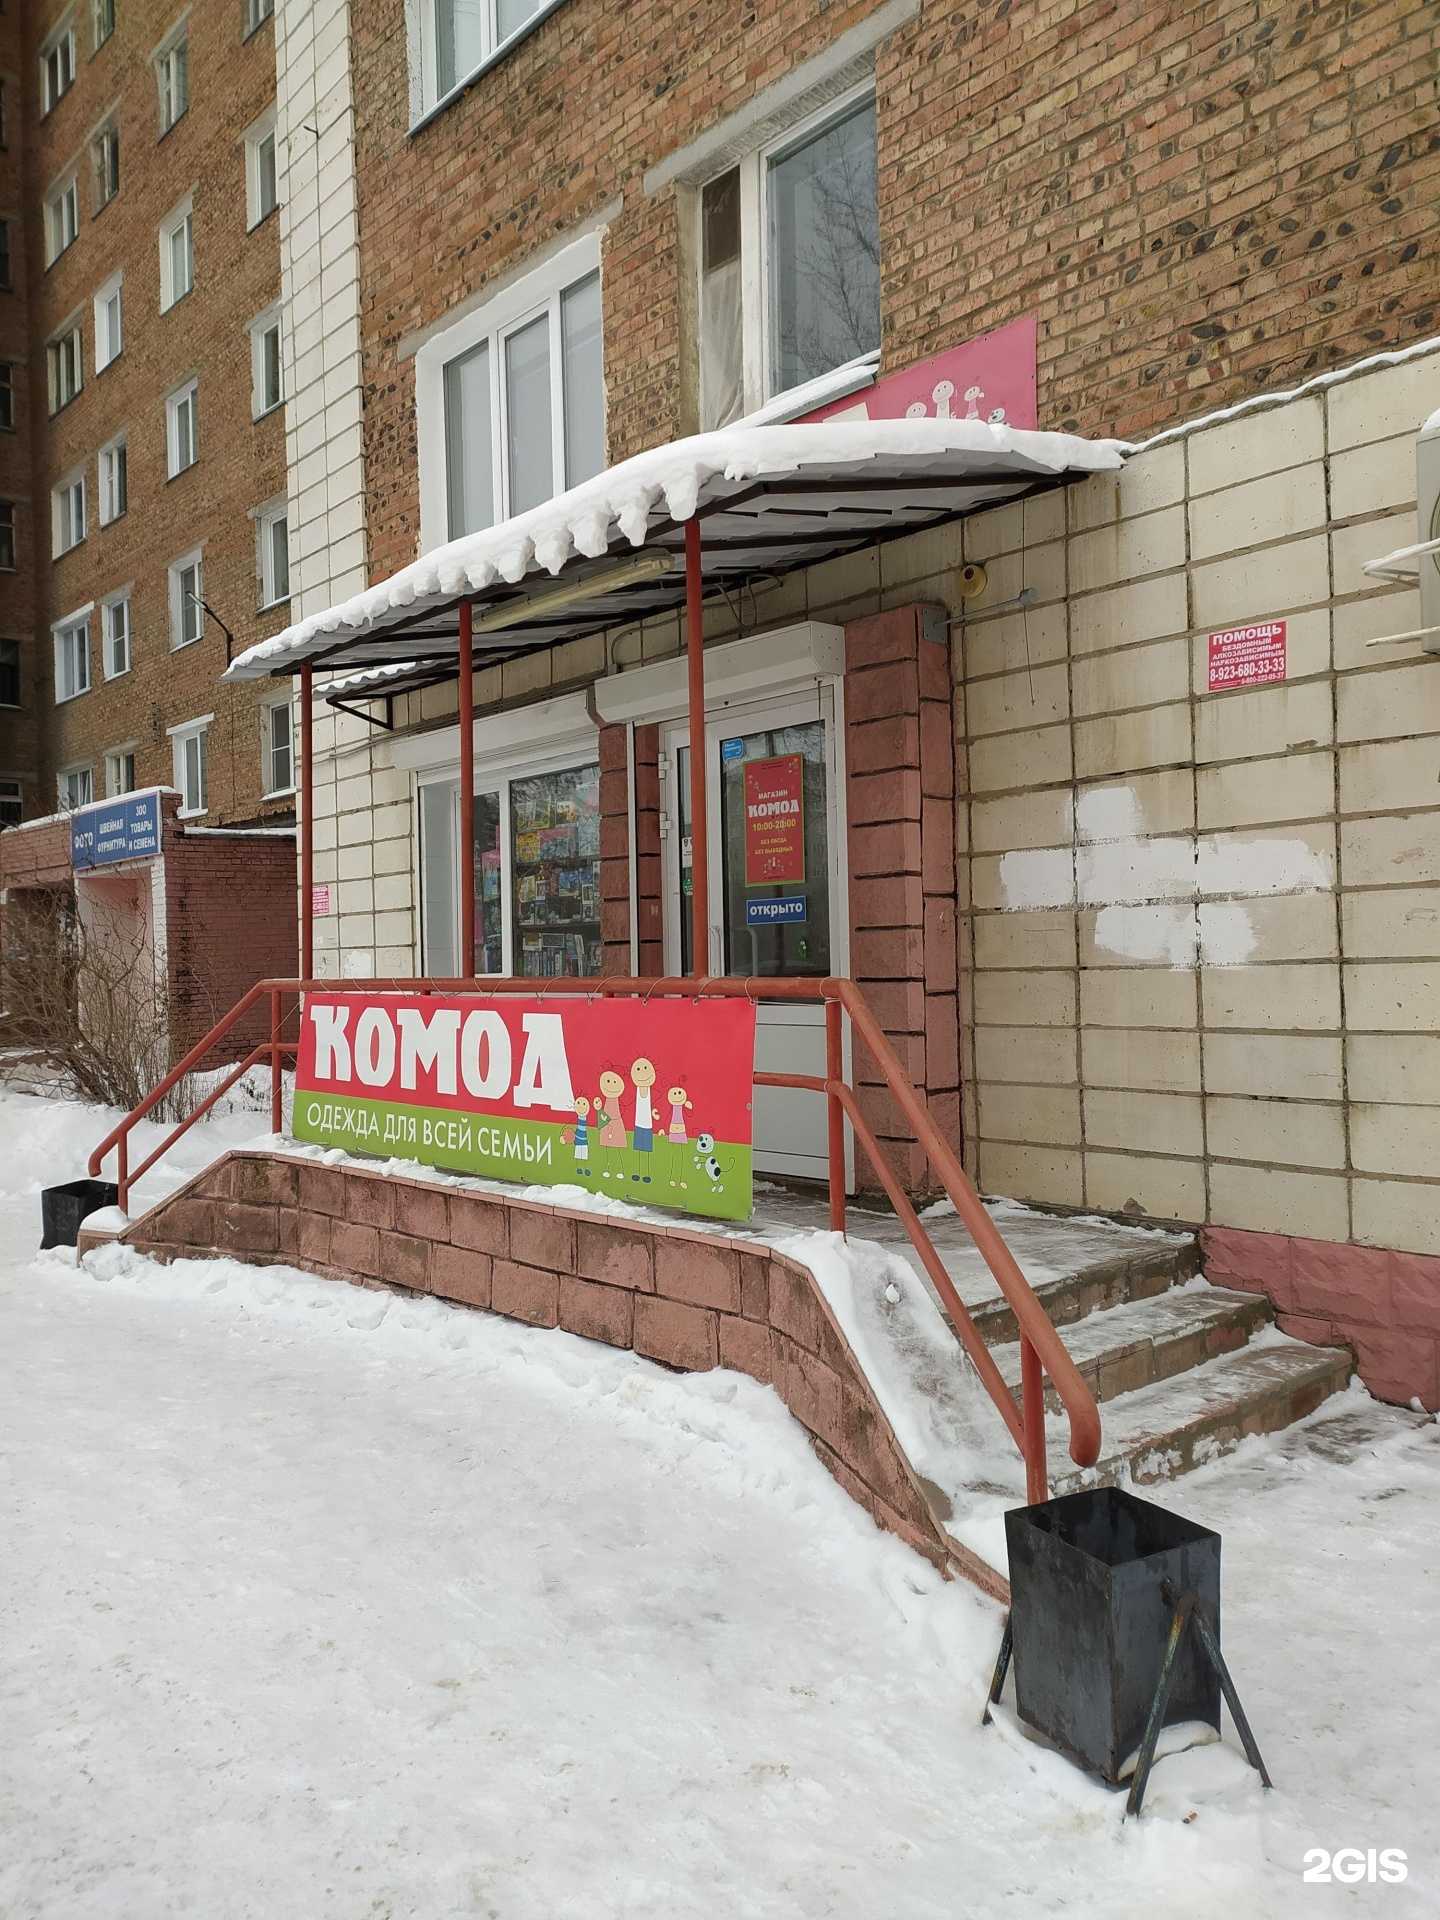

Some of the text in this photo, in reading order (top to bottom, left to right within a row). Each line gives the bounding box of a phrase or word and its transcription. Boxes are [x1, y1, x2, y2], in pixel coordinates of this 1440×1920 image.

[1212, 624, 1282, 645] ПОМОЩЬ
[1212, 643, 1282, 660] АЛКОЗАВИСИМЫМ
[1222, 638, 1272, 652] БЕЗДОМНЫМ
[1210, 649, 1285, 667] НАРКОЗАВИСИМЫМ
[1210, 657, 1285, 682] 8-923-680-33-33
[758, 788, 788, 800] МАГАЗИН
[135, 804, 147, 817] ЗОО
[747, 799, 800, 818] КОМОД
[99, 818, 124, 835] ШВЕЙНАЯ
[130, 819, 153, 834] ТОВАРЫ
[752, 818, 797, 832] 10:00-20:00
[74, 831, 94, 849] ФОТО
[97, 836, 126, 854] ФУРНИТУРА
[133, 836, 156, 850] СЕМЕНА
[310, 1004, 576, 1113] КОМОД
[306, 1102, 553, 1166] ОДЕЖДА ДЛЯ ВСЕЙ СЕМЬИ
